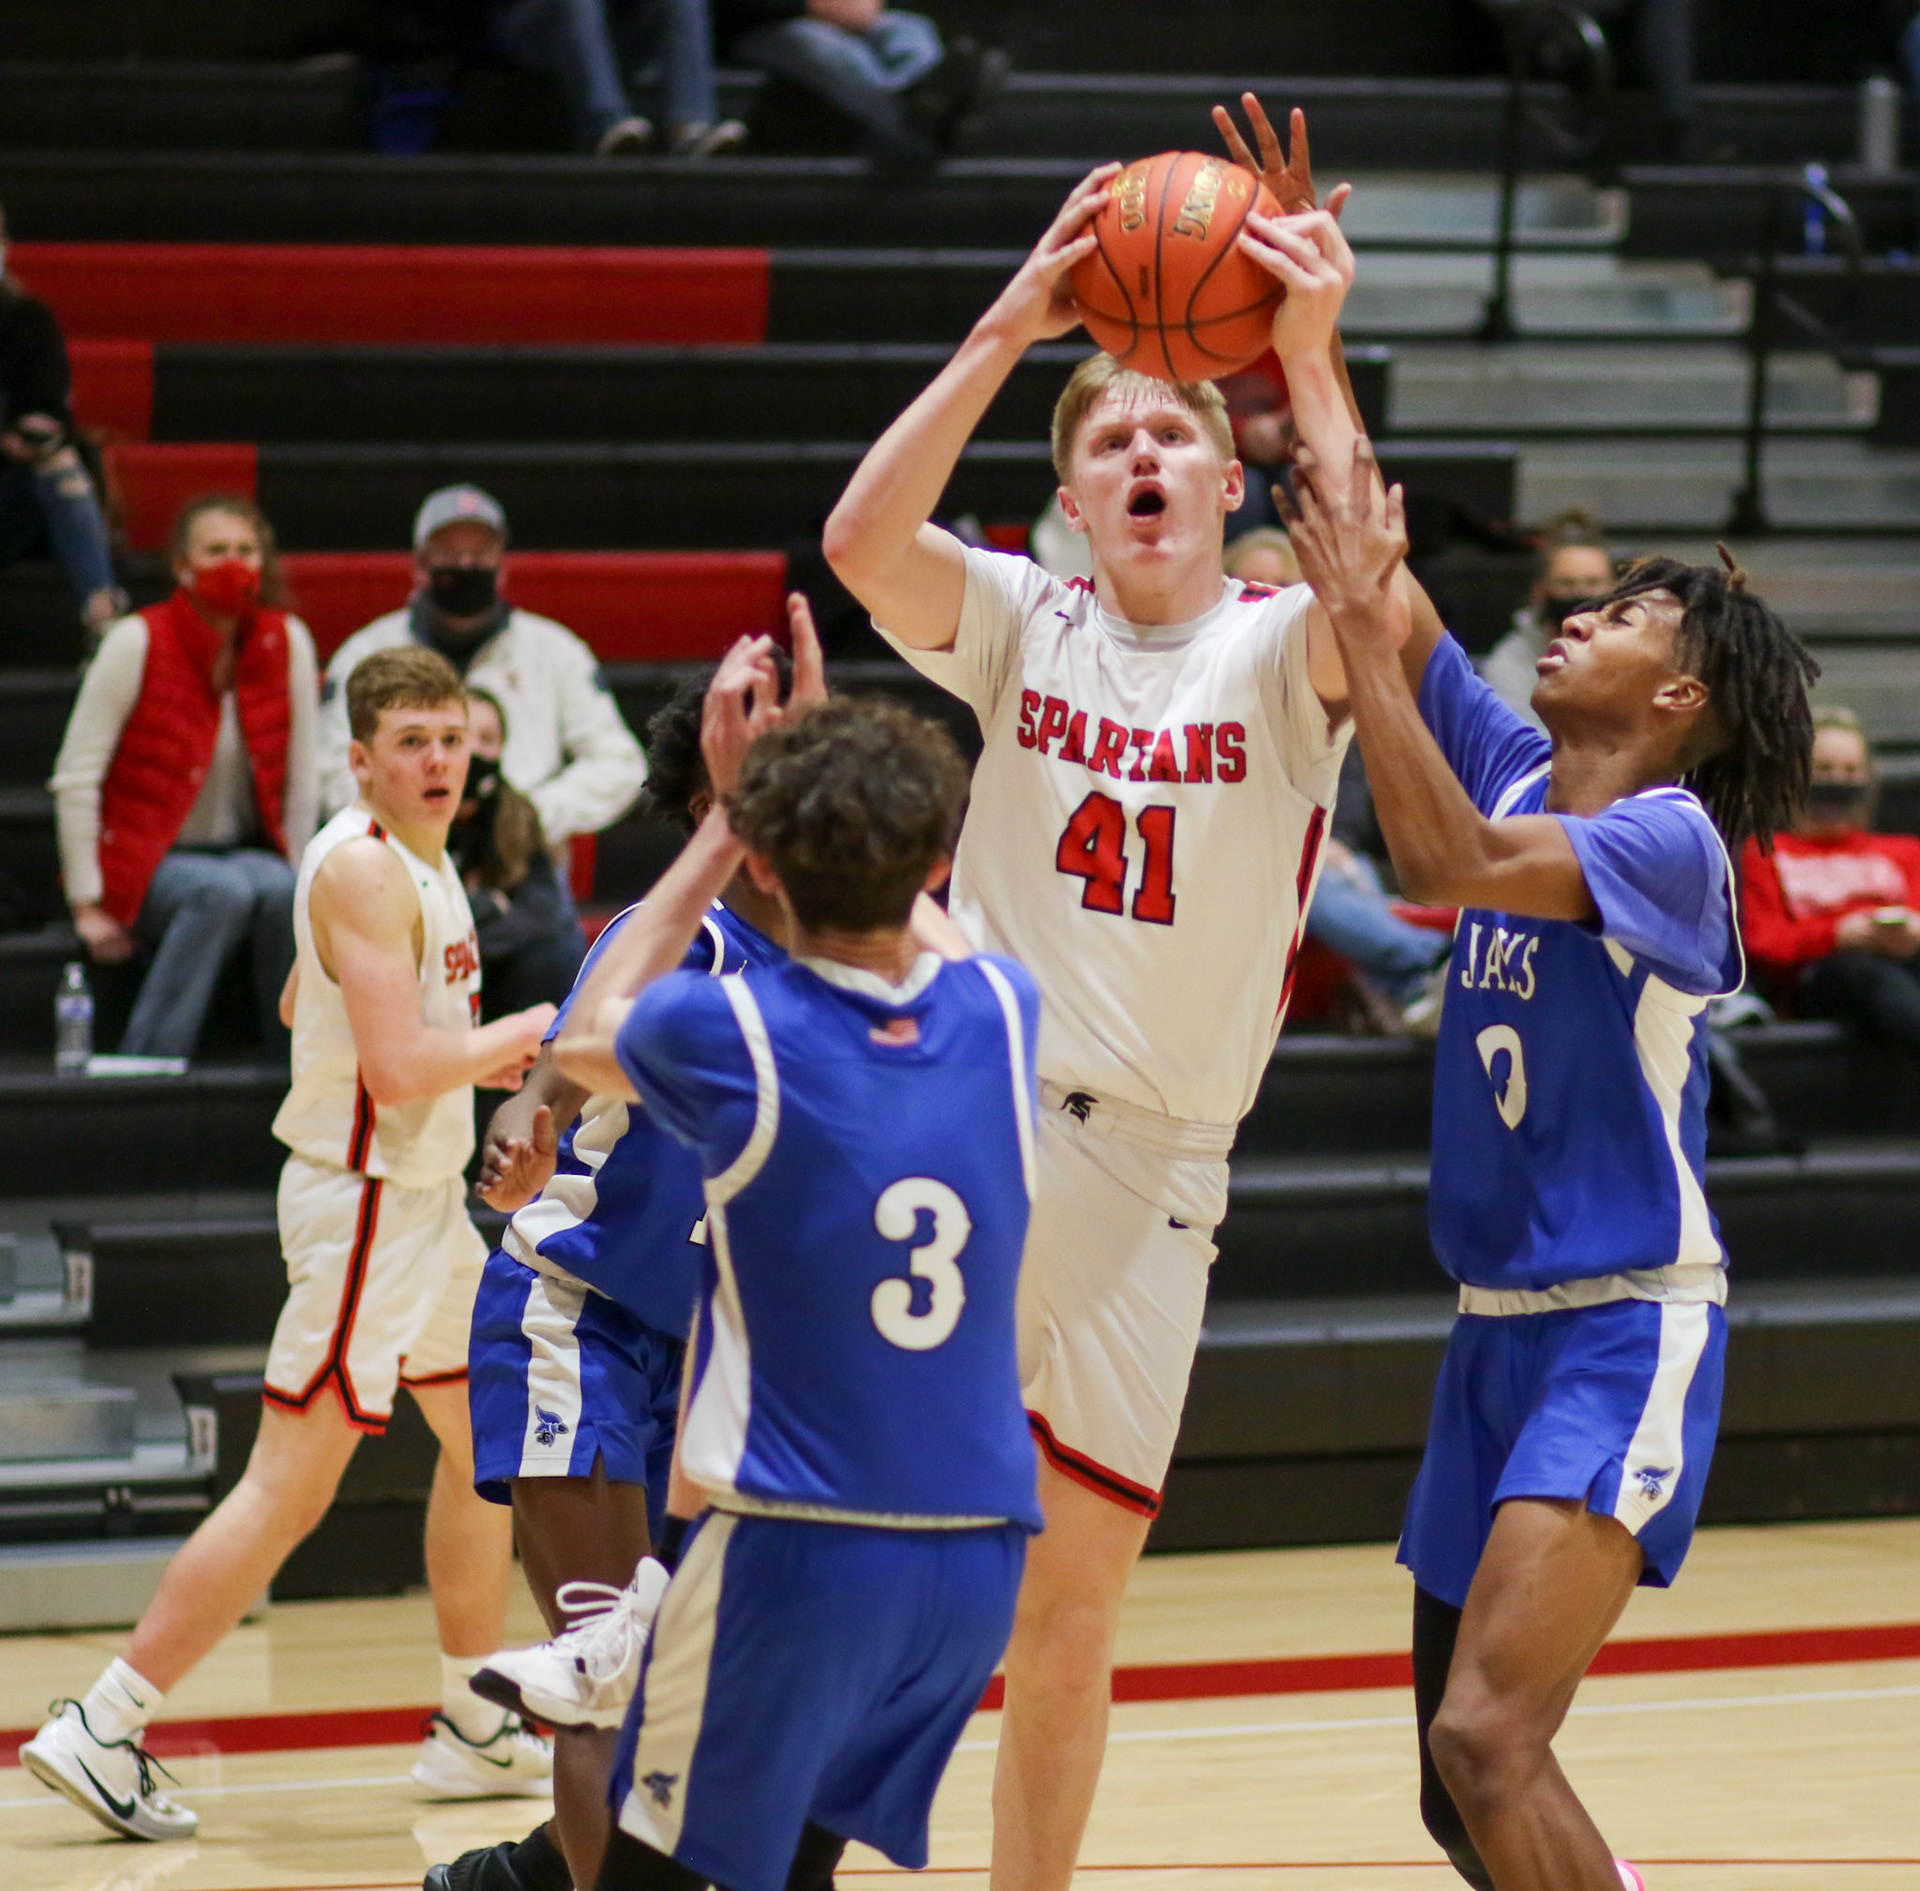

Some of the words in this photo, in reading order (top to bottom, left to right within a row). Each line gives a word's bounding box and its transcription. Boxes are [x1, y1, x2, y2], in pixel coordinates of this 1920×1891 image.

[1017, 688, 1247, 783] SPARTANS
[1056, 790, 1176, 926] 41
[1461, 922, 1539, 1000] JAYS
[871, 1177, 973, 1351] 3
